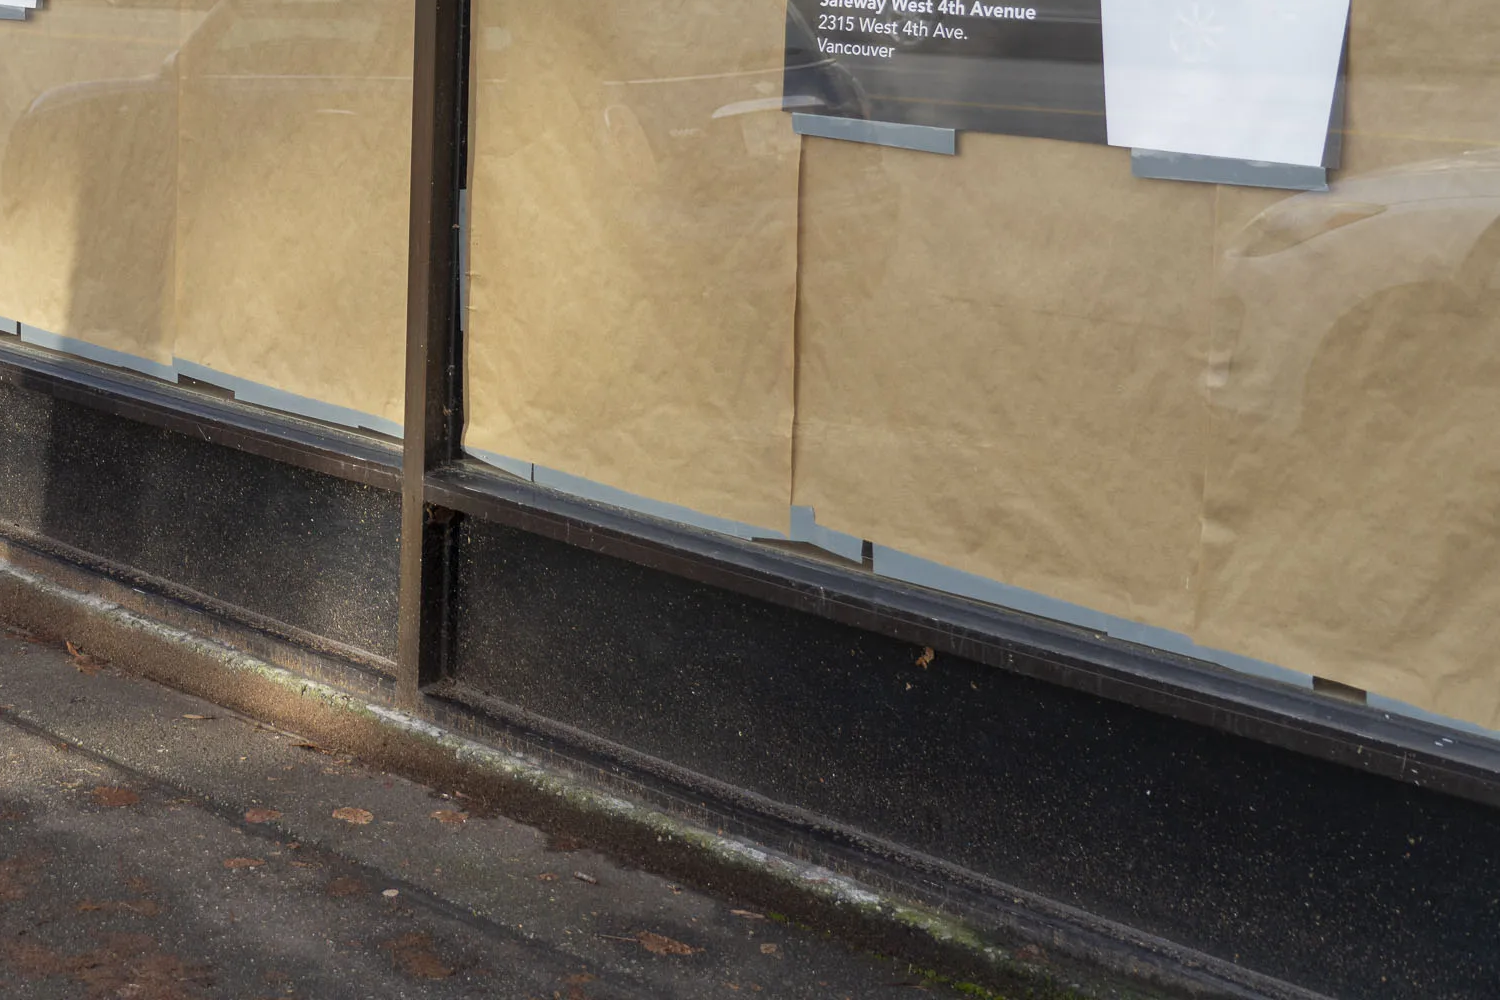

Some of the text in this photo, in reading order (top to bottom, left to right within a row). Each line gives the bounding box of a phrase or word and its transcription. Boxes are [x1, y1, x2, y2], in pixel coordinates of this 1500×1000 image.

[970, 0, 1037, 20] Avenue
[818, 14, 969, 40] 2315 West 4th Ave.
[816, 37, 896, 58] Vancouver
